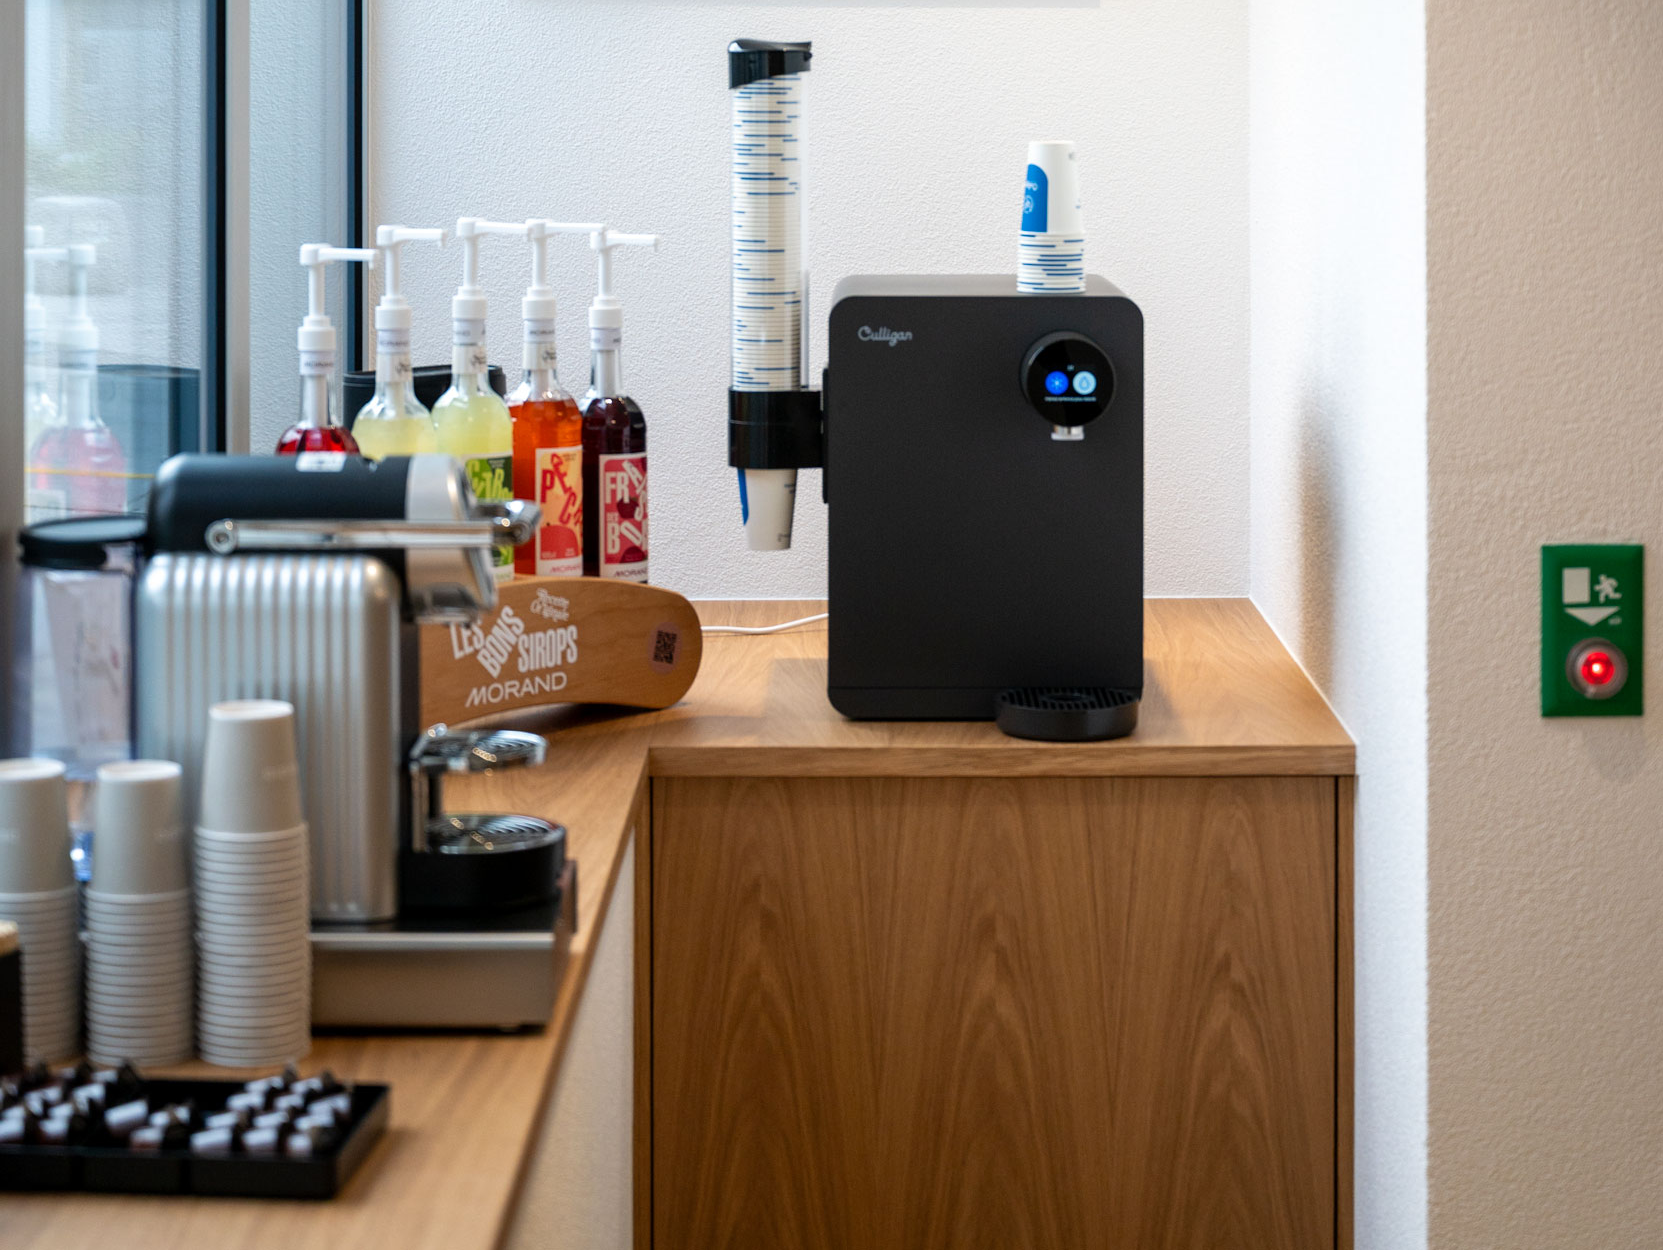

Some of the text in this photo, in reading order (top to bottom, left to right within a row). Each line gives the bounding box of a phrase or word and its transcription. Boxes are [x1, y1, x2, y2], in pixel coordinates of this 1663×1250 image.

[857, 325, 913, 347] Culligan
[450, 605, 578, 679] LES BONS SIROPS
[464, 671, 568, 708] MORAND
